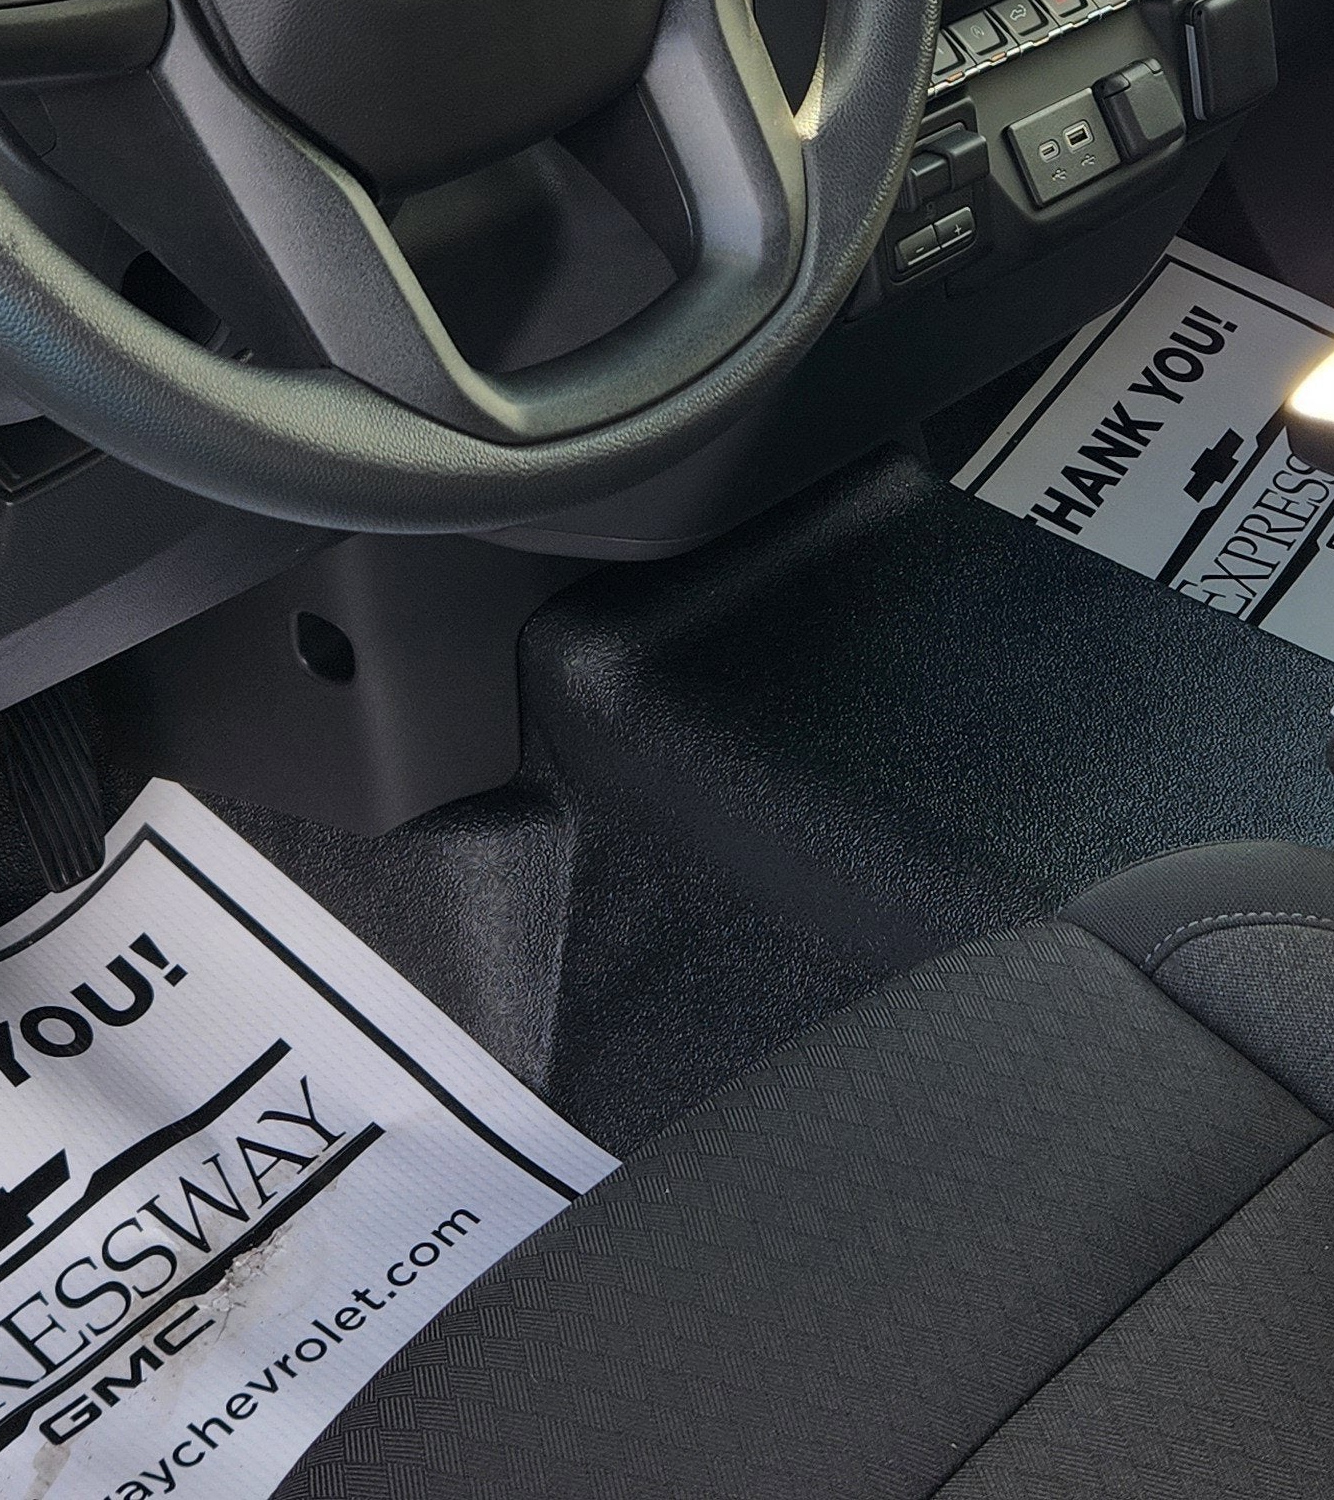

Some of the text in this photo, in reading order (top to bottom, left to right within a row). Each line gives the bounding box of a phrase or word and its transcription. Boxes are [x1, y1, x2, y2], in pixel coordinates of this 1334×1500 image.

[1021, 305, 1238, 535] HANK YOU!
[38, 1304, 216, 1445] GMC
[103, 1206, 482, 1500] aychevrolet.com
